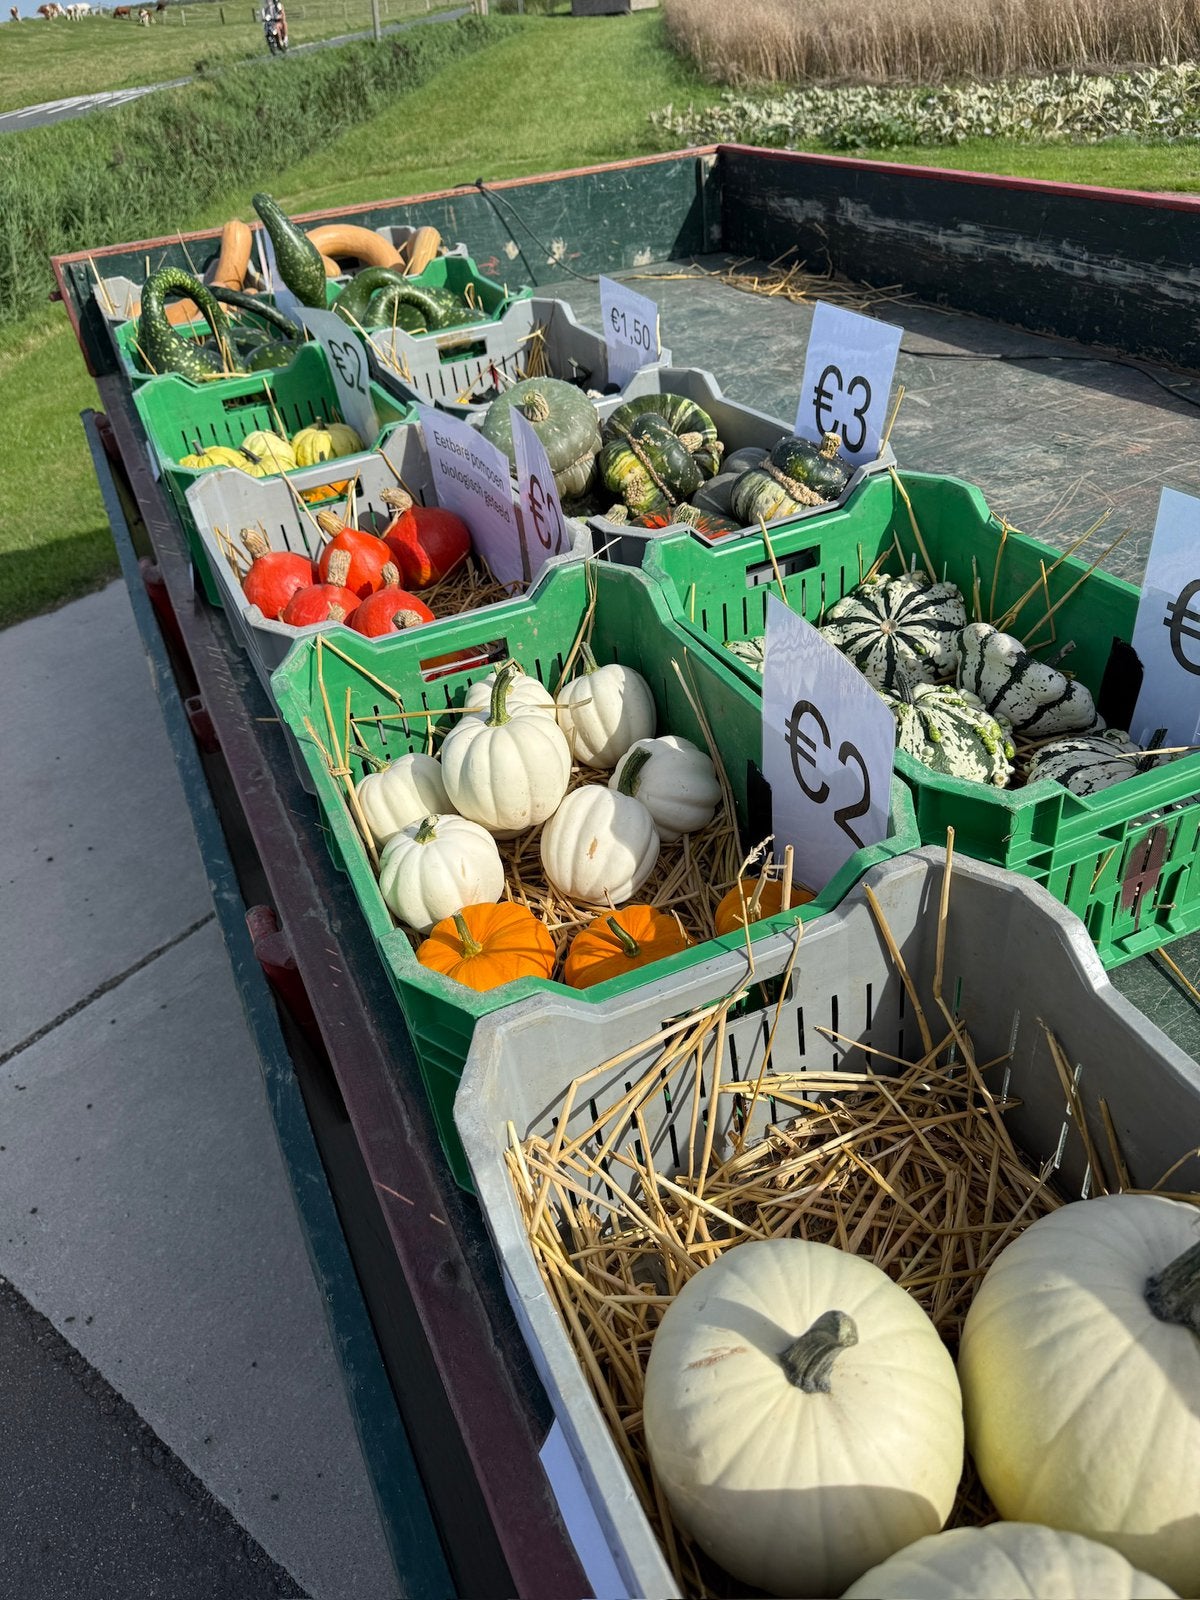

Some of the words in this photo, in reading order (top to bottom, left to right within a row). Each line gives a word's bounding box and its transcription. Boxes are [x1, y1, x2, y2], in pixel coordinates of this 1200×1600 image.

[611, 307, 651, 351] €1,50
[328, 339, 367, 395] €2
[813, 364, 872, 453] €3
[433, 430, 471, 462] Eetbare
[470, 453, 505, 492] pompoen
[440, 459, 484, 497] biologisch
[784, 699, 871, 850] €2
